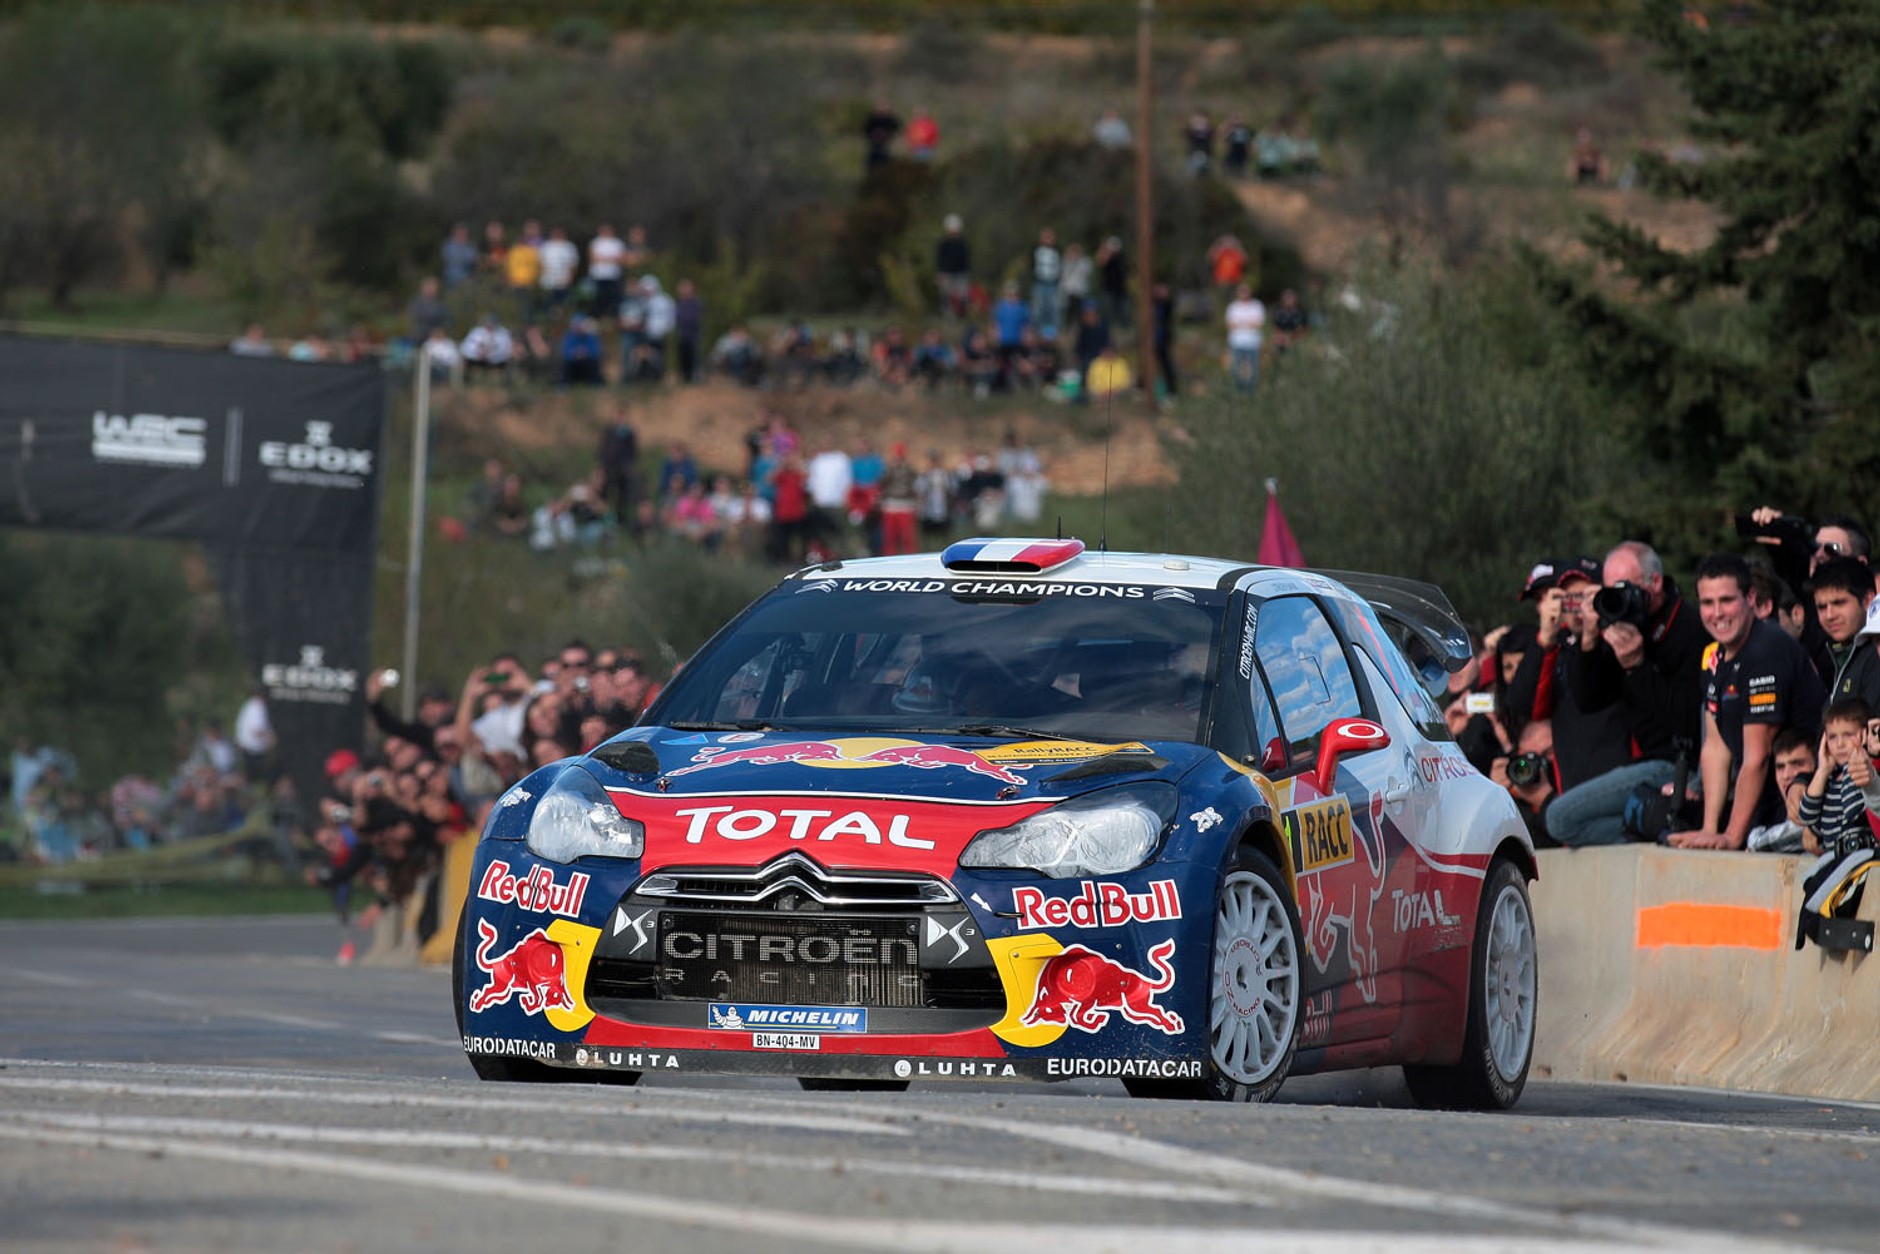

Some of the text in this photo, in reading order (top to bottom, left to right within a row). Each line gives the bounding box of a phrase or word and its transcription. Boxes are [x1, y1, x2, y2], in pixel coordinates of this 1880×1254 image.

[843, 579, 1145, 599] WORLD CHAMPIONS
[675, 805, 937, 851] TOTAL
[1304, 803, 1349, 865] RACC
[478, 859, 591, 919] Red Bull
[1012, 879, 1184, 930] Red Bull
[1392, 889, 1460, 934] TOTAL
[747, 1008, 860, 1026] MICHELIN
[463, 1035, 556, 1059] EURODATACAR
[594, 1050, 680, 1068] LUHTA
[918, 1062, 1017, 1077] LUHTA
[1047, 1058, 1202, 1077] EURODATACAR
